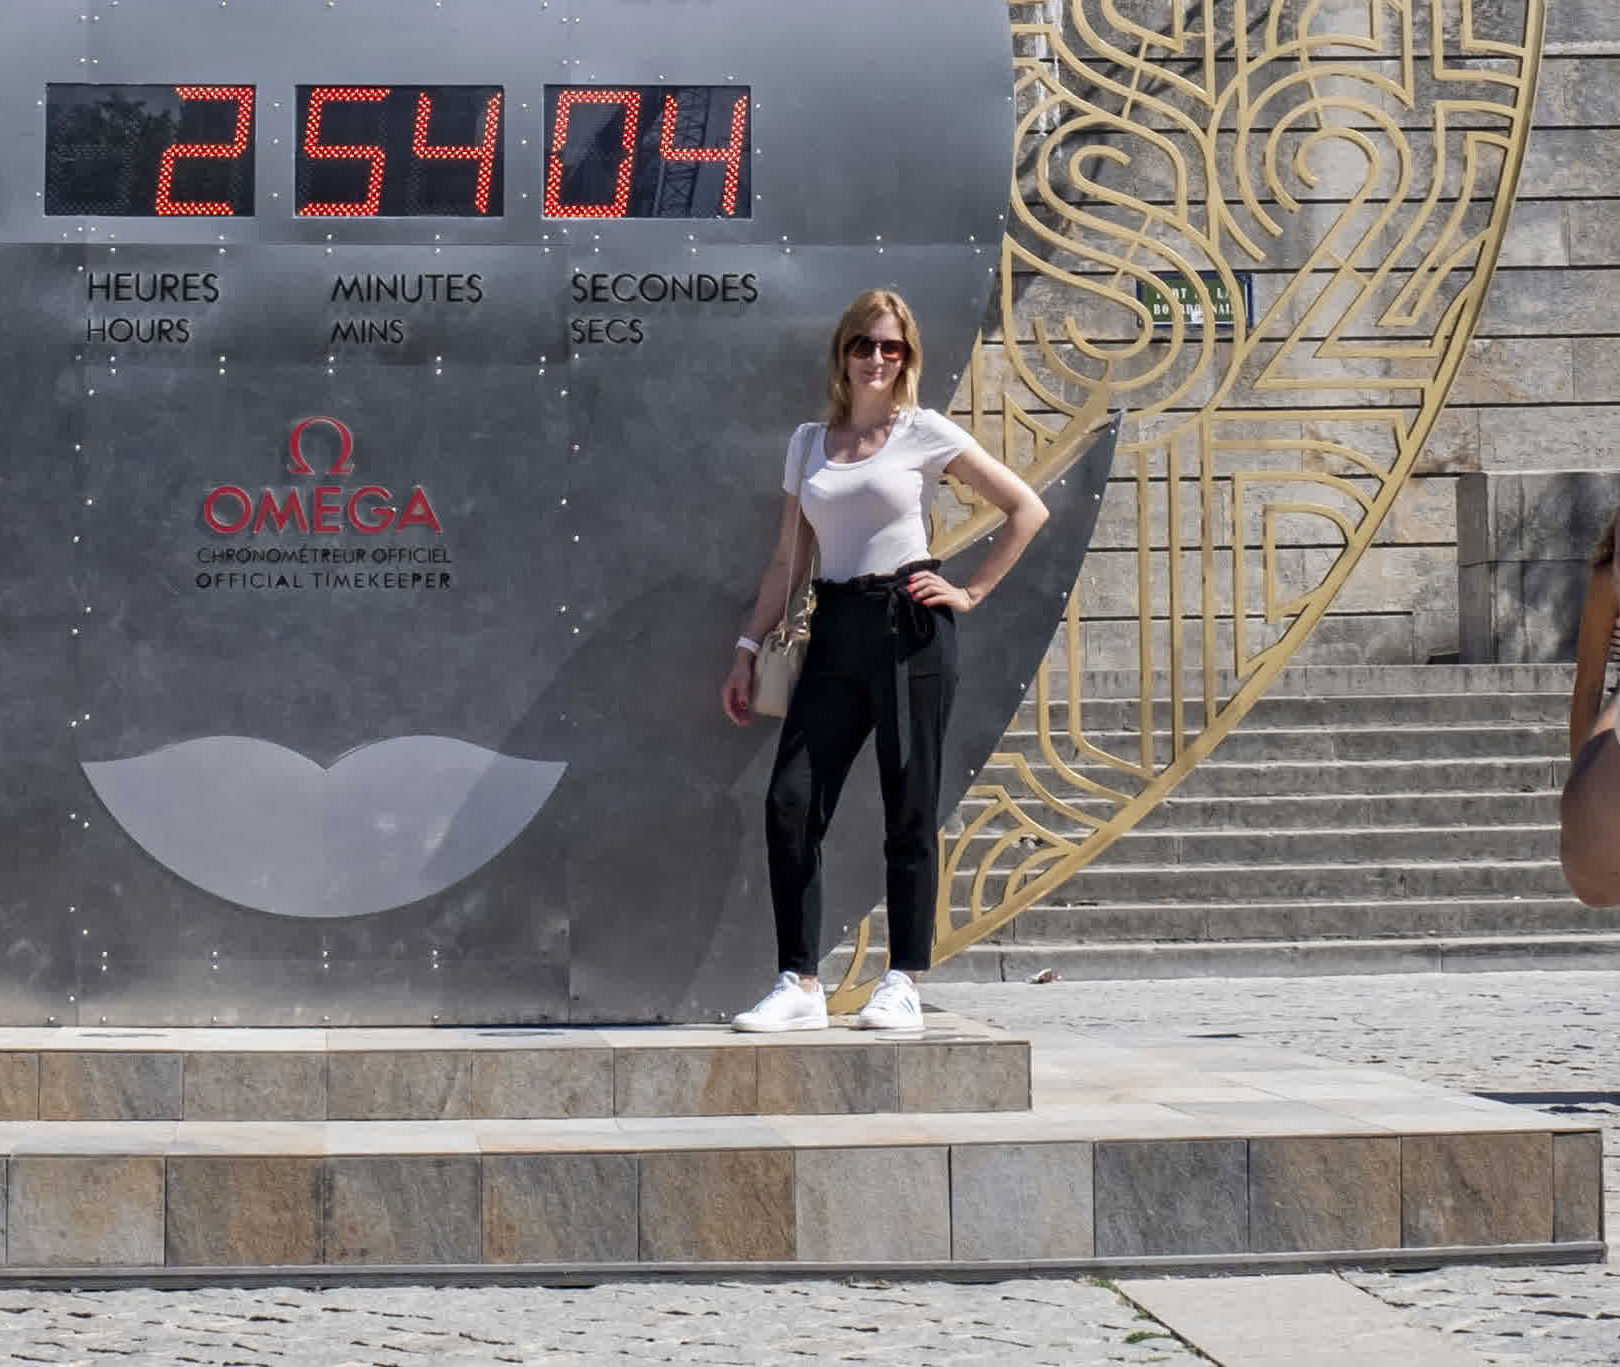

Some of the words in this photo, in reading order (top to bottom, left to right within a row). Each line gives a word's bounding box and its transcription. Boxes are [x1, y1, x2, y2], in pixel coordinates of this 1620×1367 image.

[156, 87, 255, 217] 2
[299, 88, 503, 217] 54
[543, 90, 747, 218] 04
[87, 274, 219, 303] HEURES
[330, 275, 483, 302] MINUTES
[571, 274, 758, 303] SECONDES
[86, 318, 189, 343] HOURS
[330, 319, 403, 343] MINS
[571, 319, 643, 344] SECS
[203, 485, 443, 534] OMEGA
[371, 547, 451, 564] OFFICIEL
[195, 572, 302, 589] OFFICIAL
[313, 572, 451, 589] TIMEKEEPER
